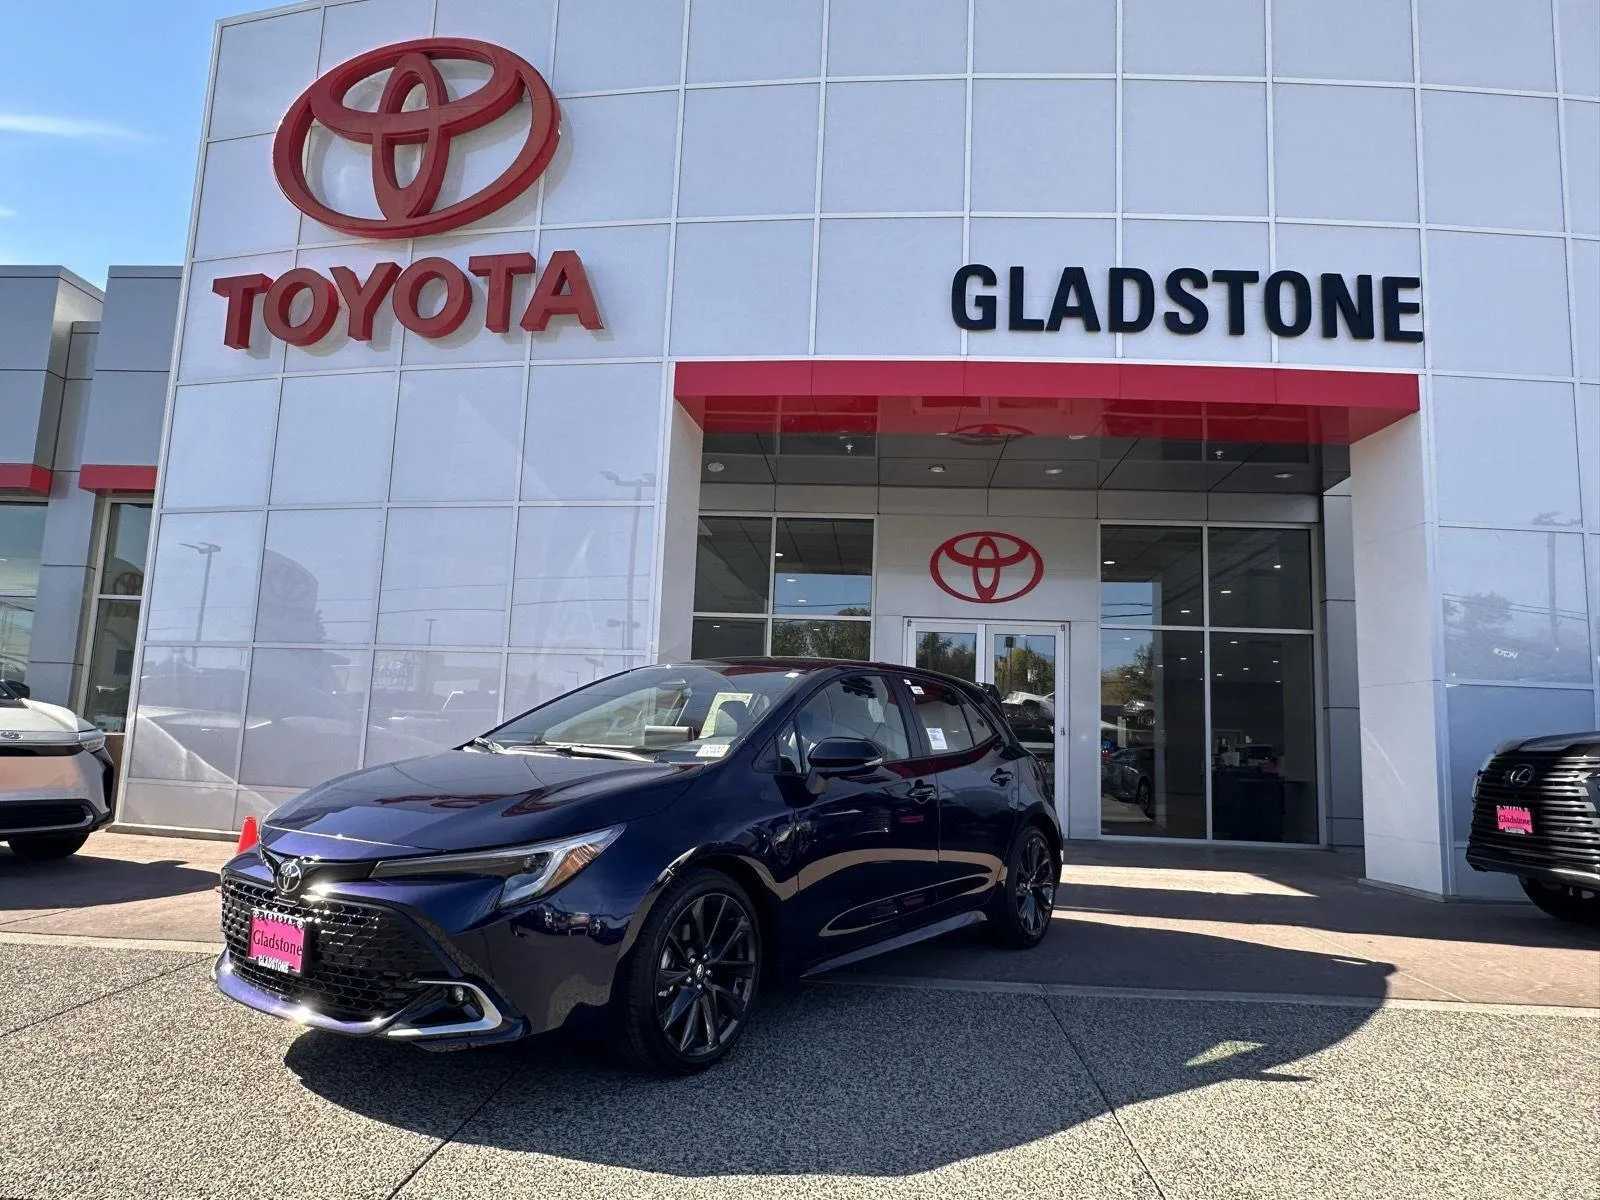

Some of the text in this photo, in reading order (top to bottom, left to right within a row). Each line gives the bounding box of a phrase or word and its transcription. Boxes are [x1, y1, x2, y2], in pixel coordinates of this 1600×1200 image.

[212, 250, 604, 349] TOYOTA
[951, 264, 1424, 342] GLADSTONE
[1499, 815, 1529, 825] Gladstone
[253, 930, 302, 956] Gladstone
